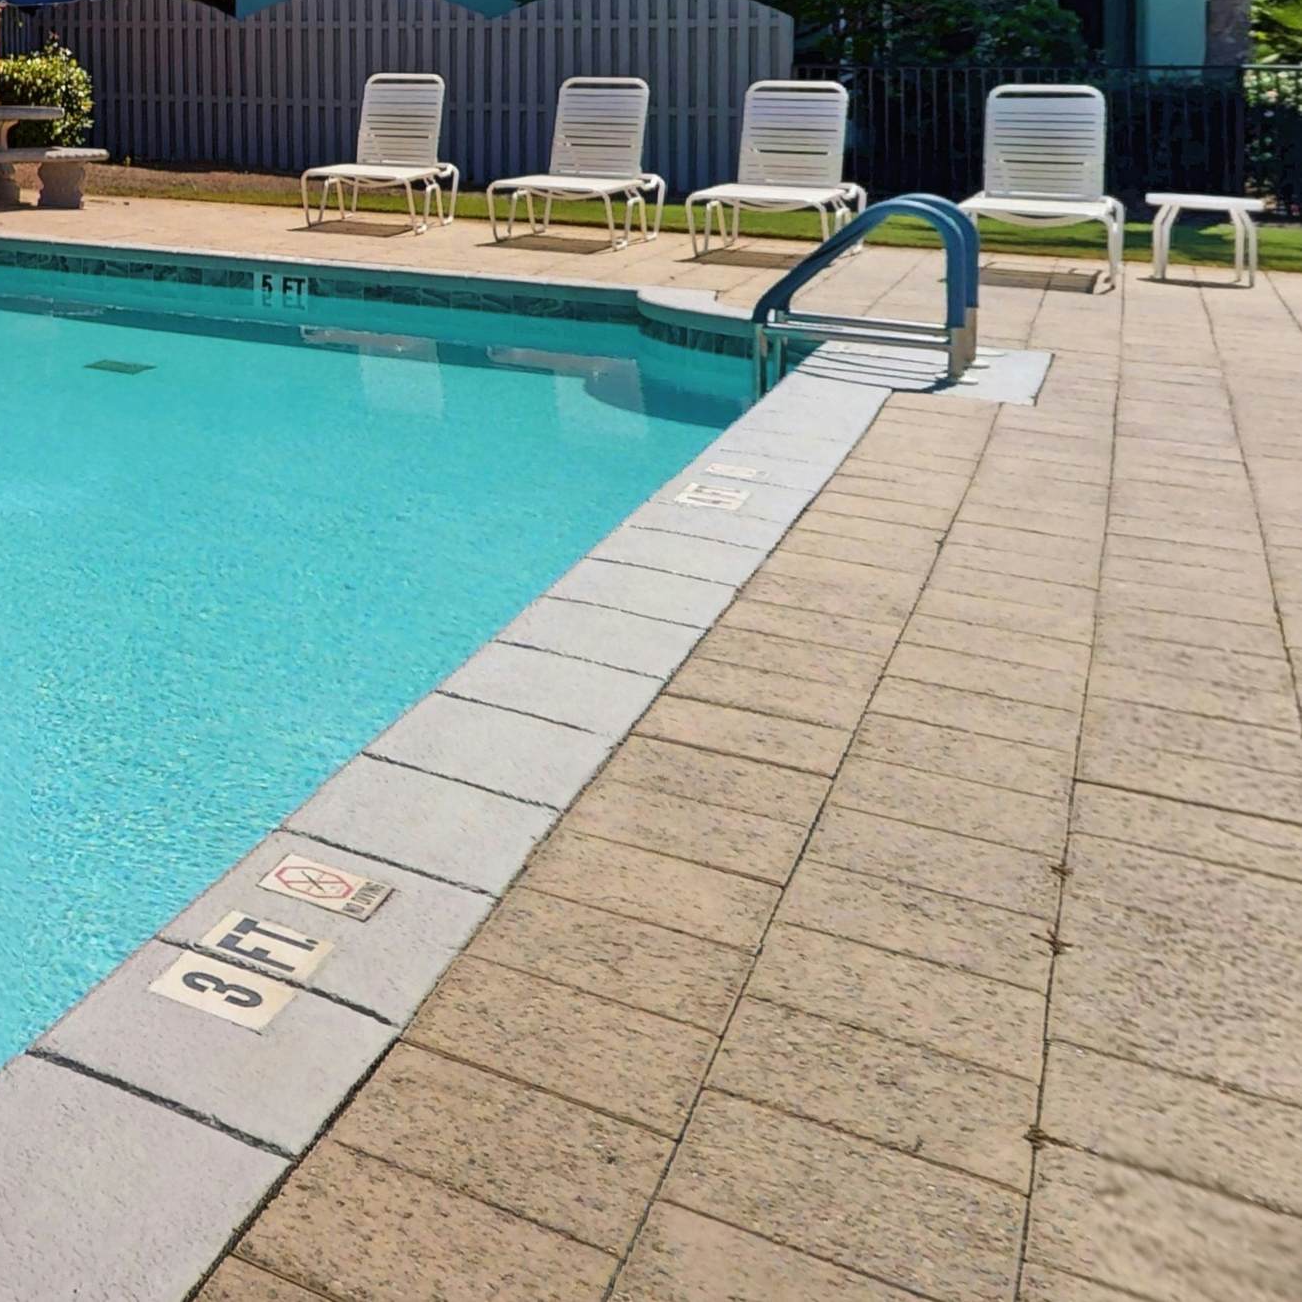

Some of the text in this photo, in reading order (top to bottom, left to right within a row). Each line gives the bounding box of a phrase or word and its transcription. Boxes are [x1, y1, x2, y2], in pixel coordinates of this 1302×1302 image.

[261, 274, 306, 295] 5 FT
[182, 971, 263, 1008] 3
